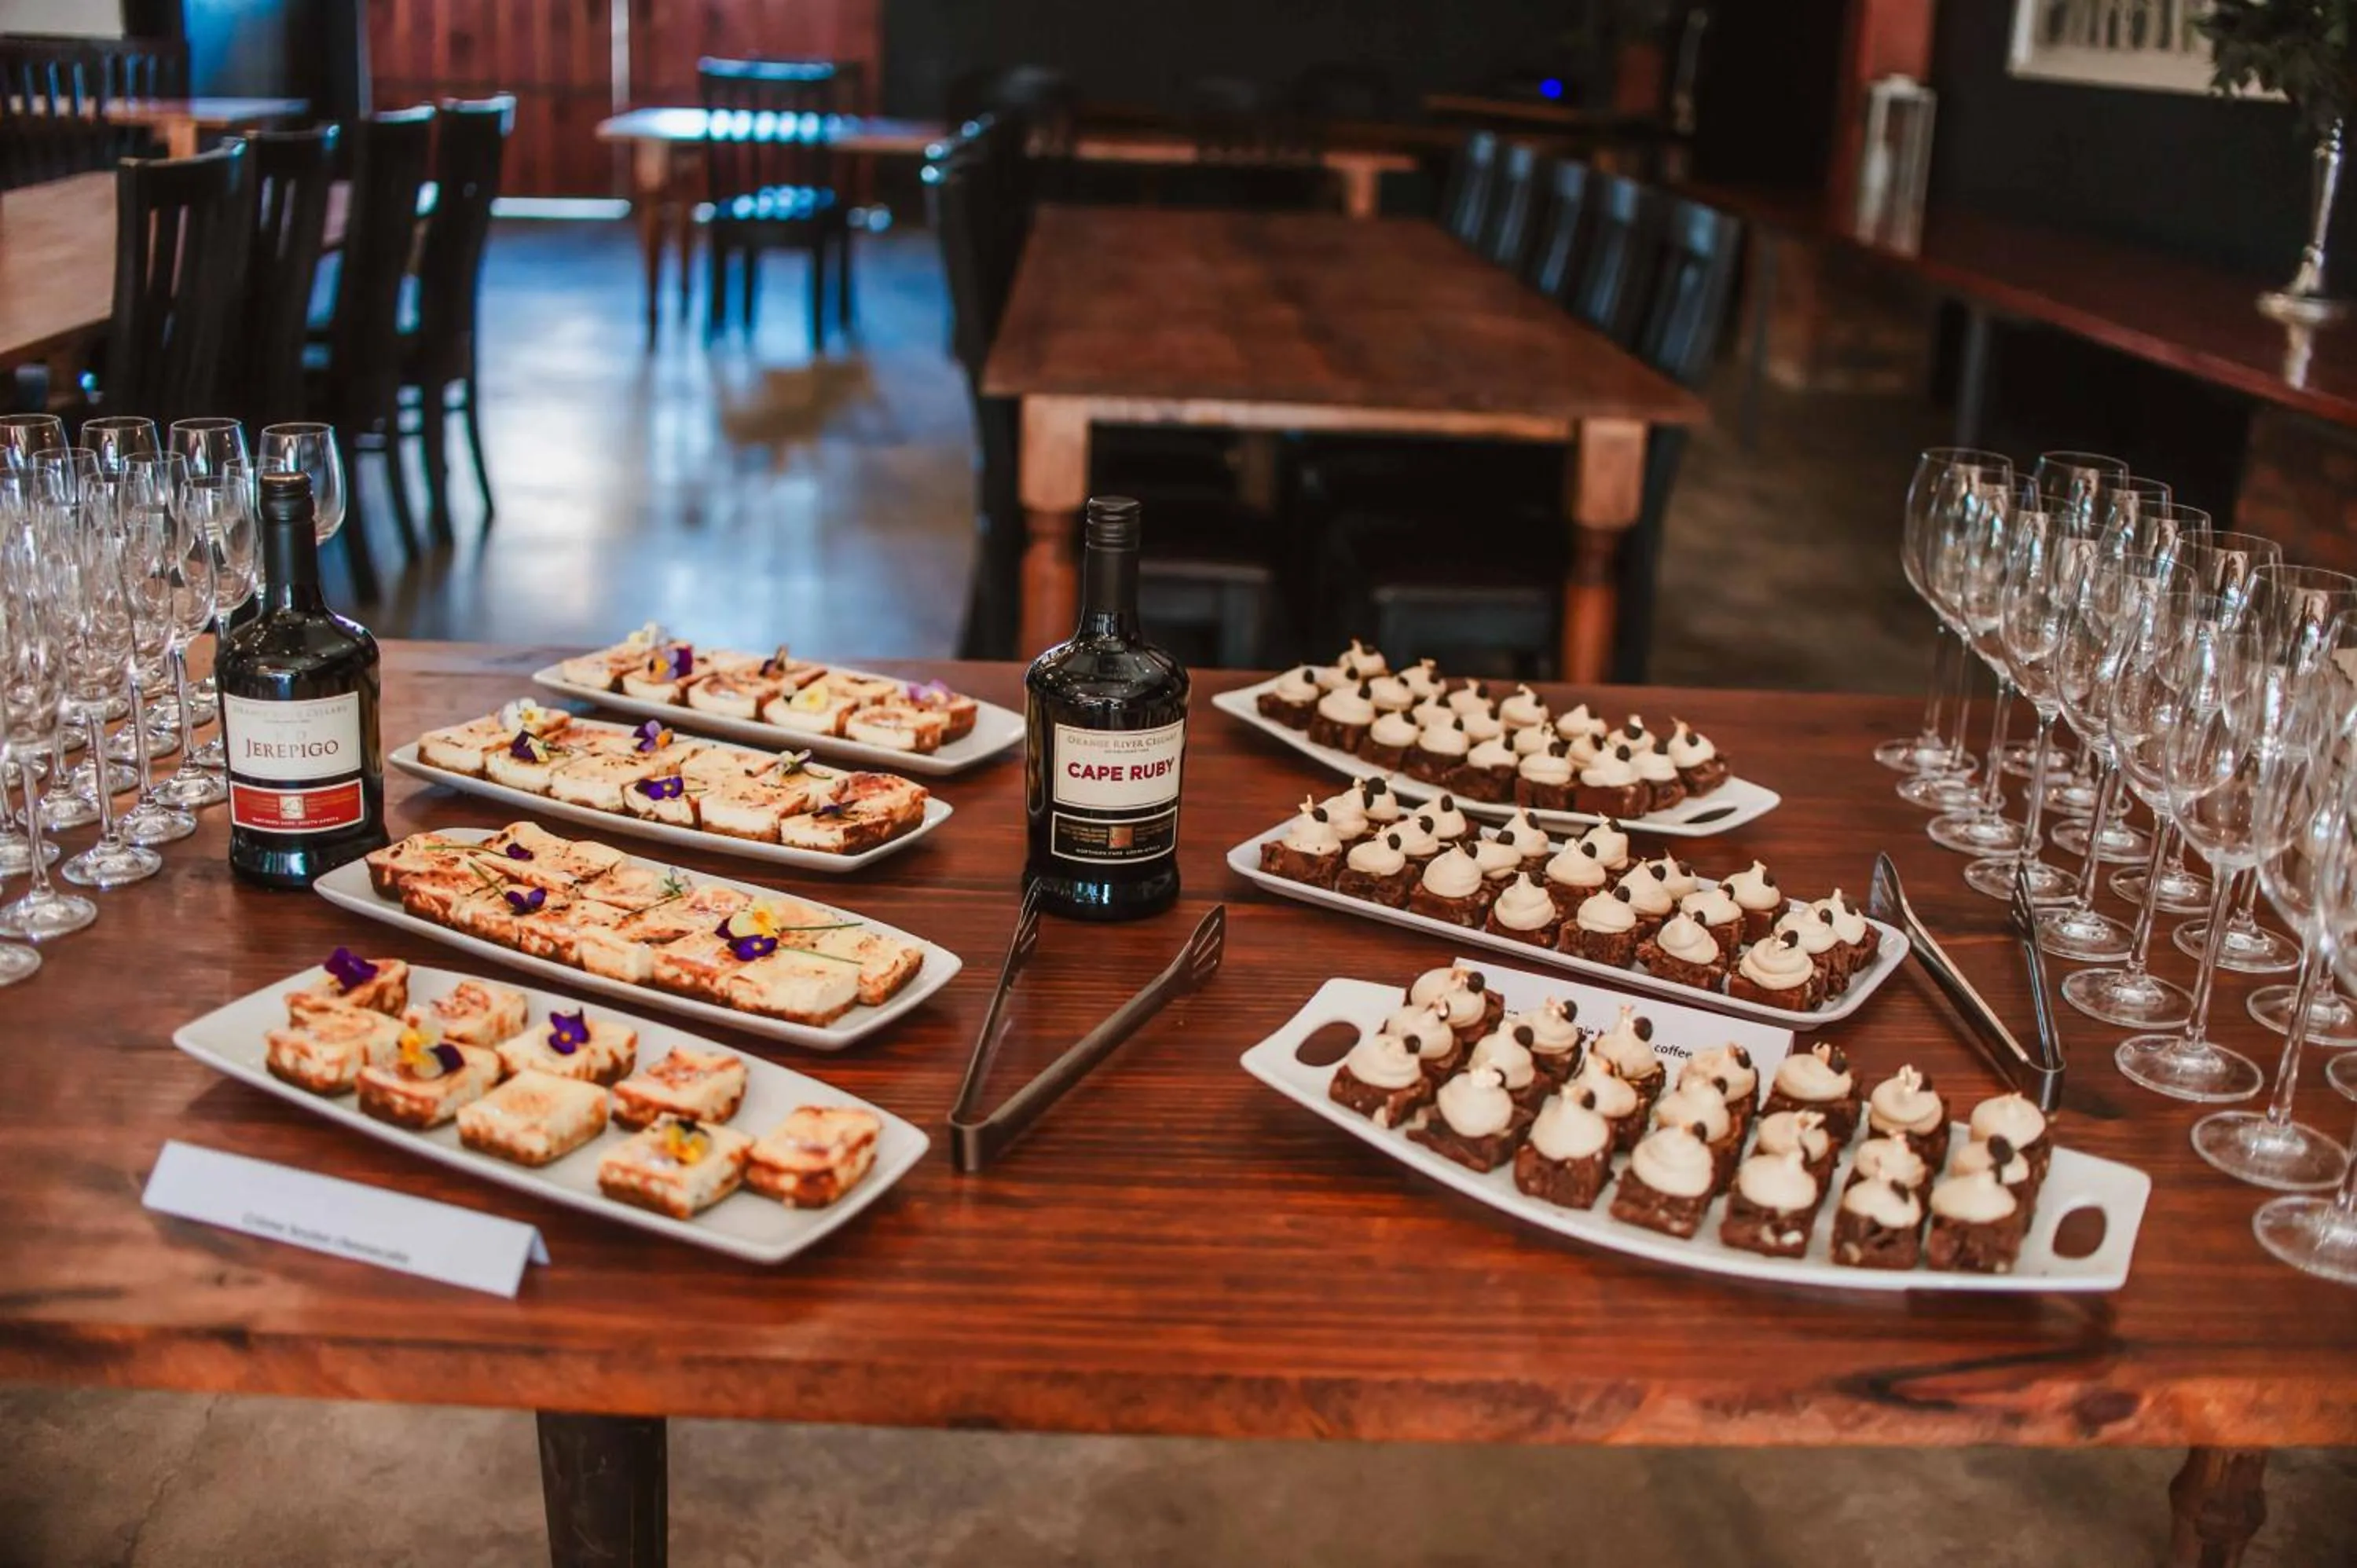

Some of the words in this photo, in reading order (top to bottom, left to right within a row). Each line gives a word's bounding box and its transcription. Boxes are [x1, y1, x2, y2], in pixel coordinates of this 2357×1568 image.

[245, 737, 339, 759] JEREPIGO
[1113, 738, 1144, 749] RIVER
[1068, 760, 1124, 781] CAPE
[1130, 755, 1175, 780] RUBY
[1654, 1042, 1693, 1059] coffee
